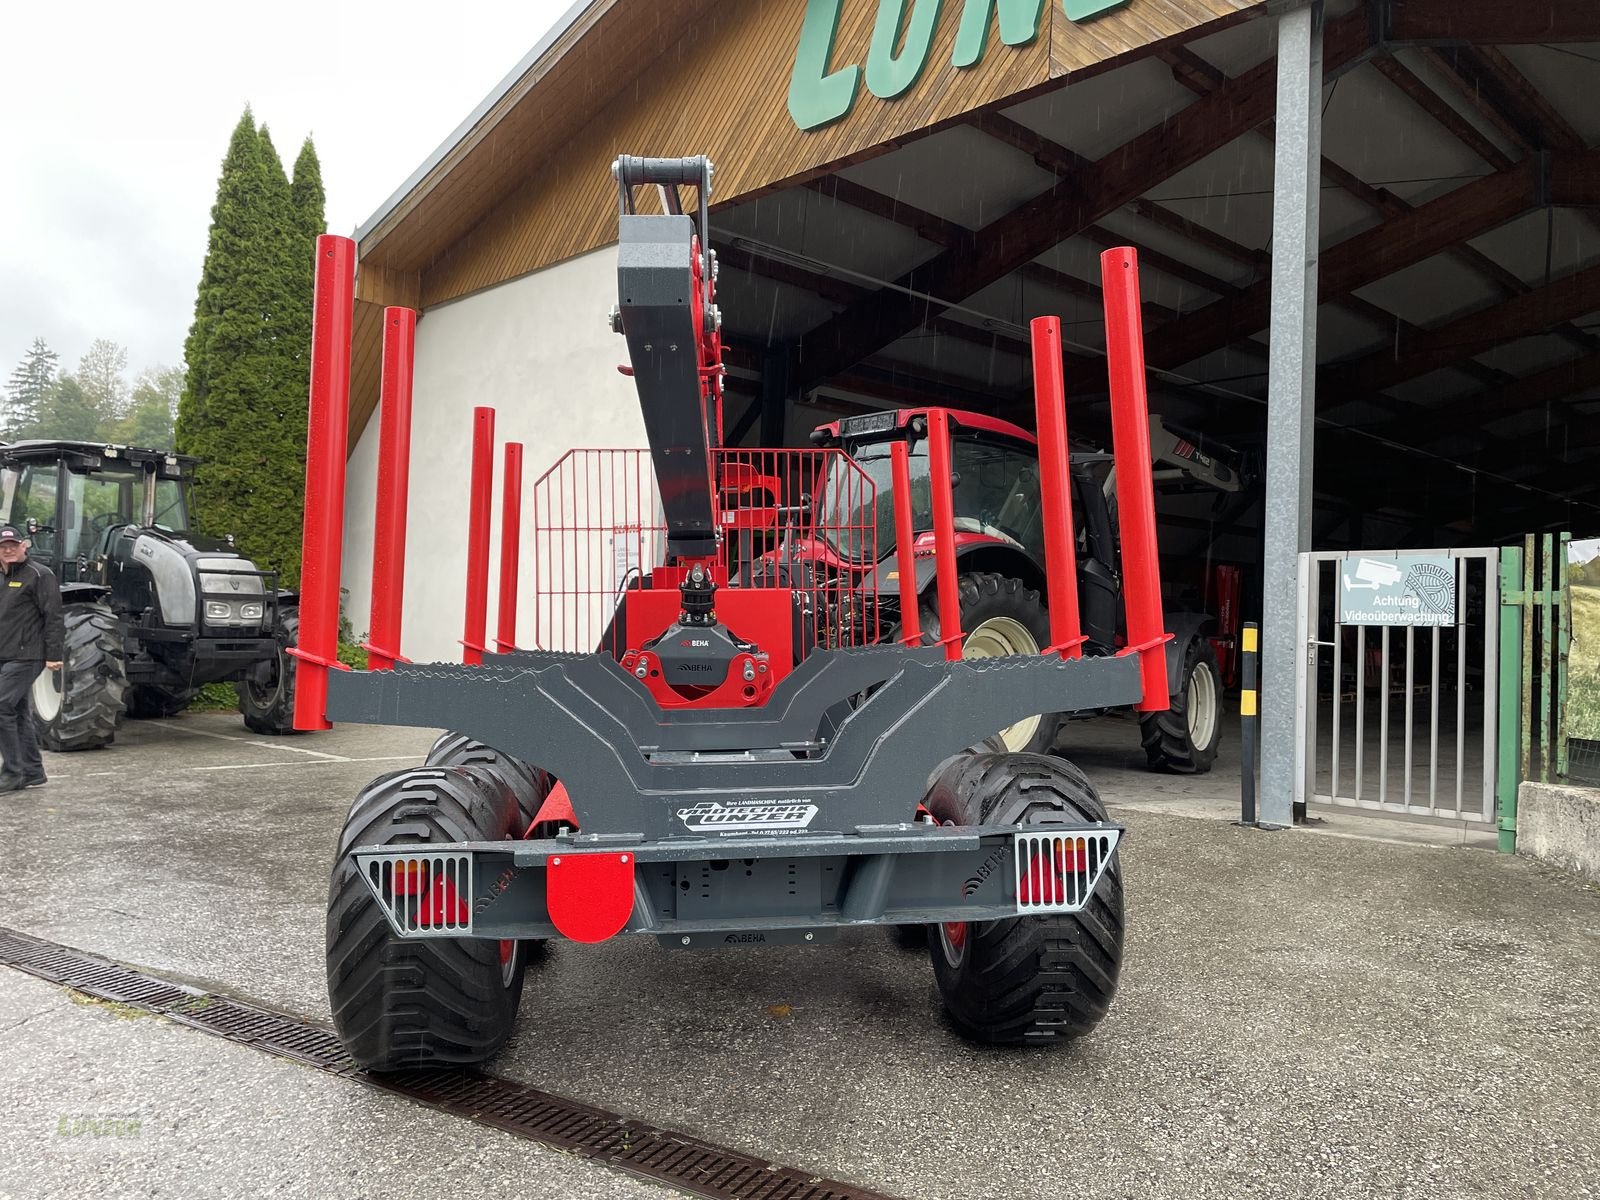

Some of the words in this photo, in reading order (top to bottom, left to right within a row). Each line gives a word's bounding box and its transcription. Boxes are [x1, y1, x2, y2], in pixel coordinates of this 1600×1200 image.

[1372, 595, 1420, 609] Achtung
[1345, 610, 1449, 624] Videoüberwachung
[692, 664, 712, 672] BEHA
[678, 805, 809, 815] LANDTECHNIK
[741, 933, 766, 943] BEHA
